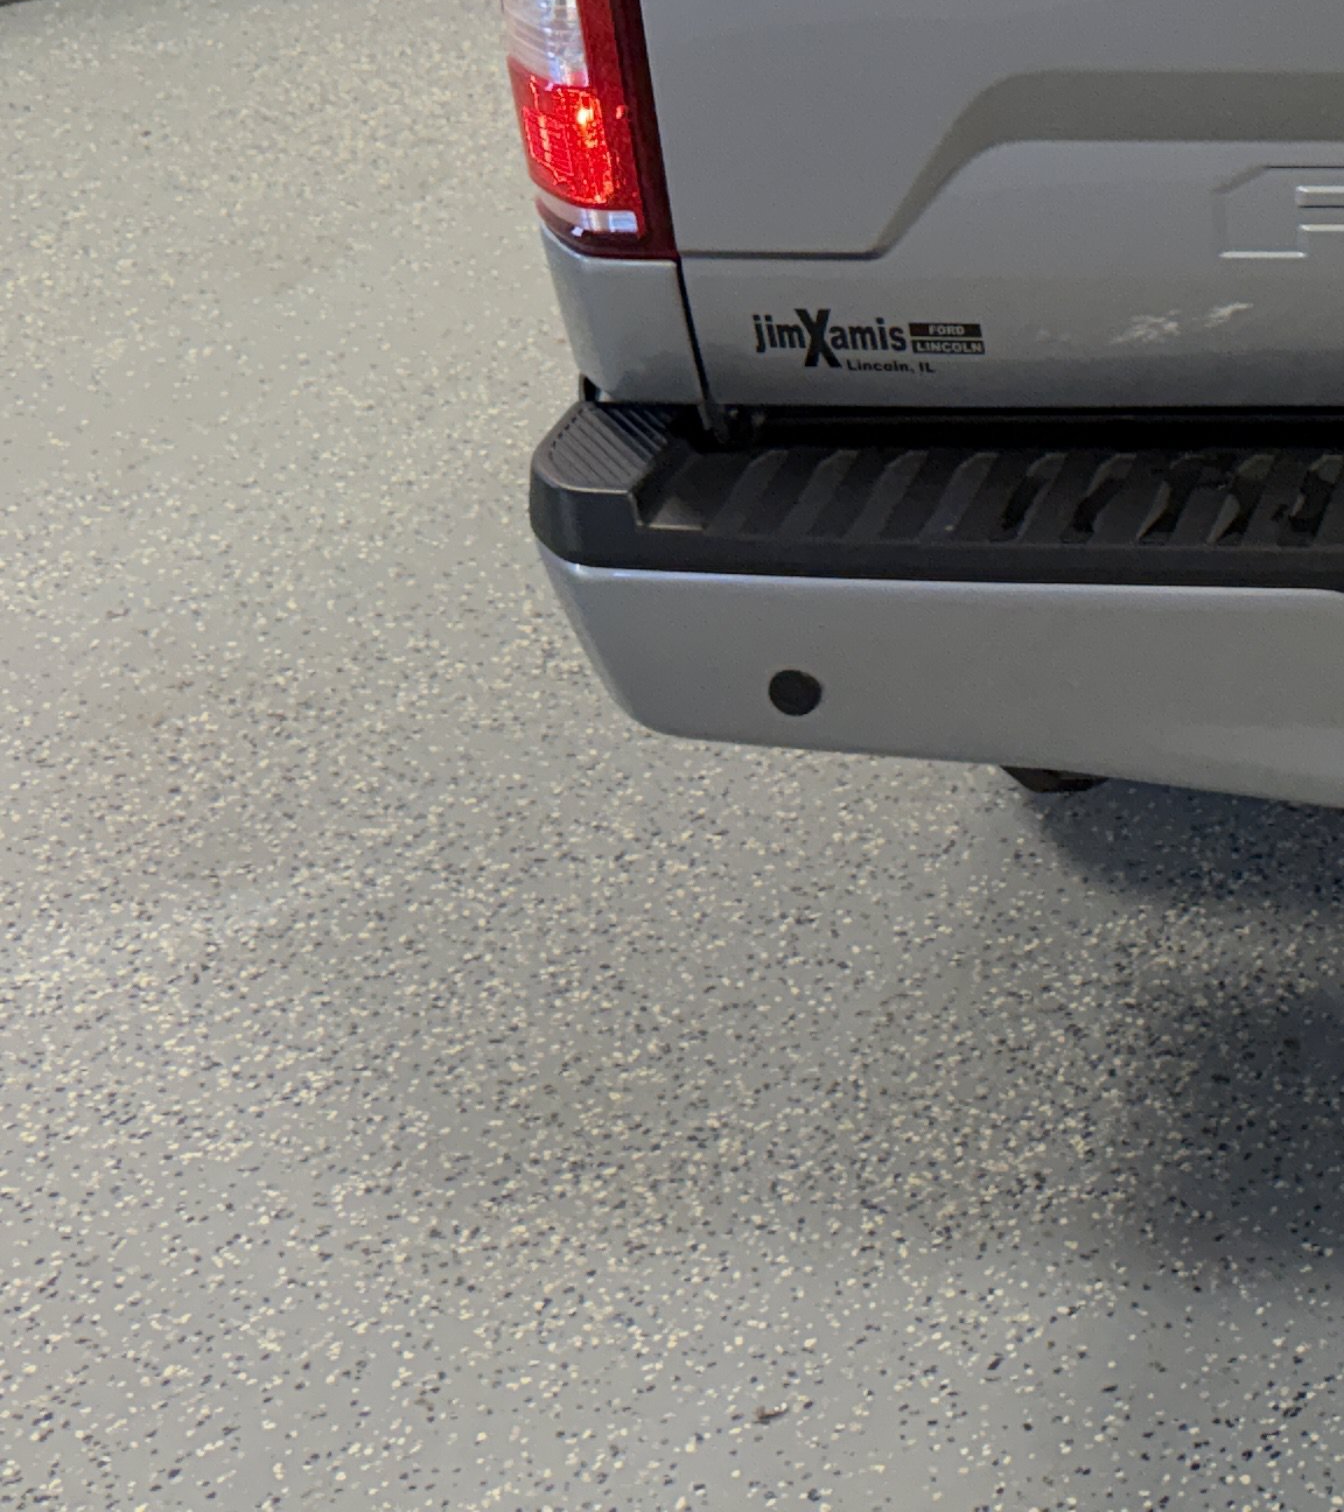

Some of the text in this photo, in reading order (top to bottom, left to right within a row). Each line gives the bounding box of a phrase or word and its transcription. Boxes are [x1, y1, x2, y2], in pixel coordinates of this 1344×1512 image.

[928, 324, 965, 336] FORD
[916, 341, 982, 353] LINCOLN
[846, 359, 936, 374] Lincoln, IL
